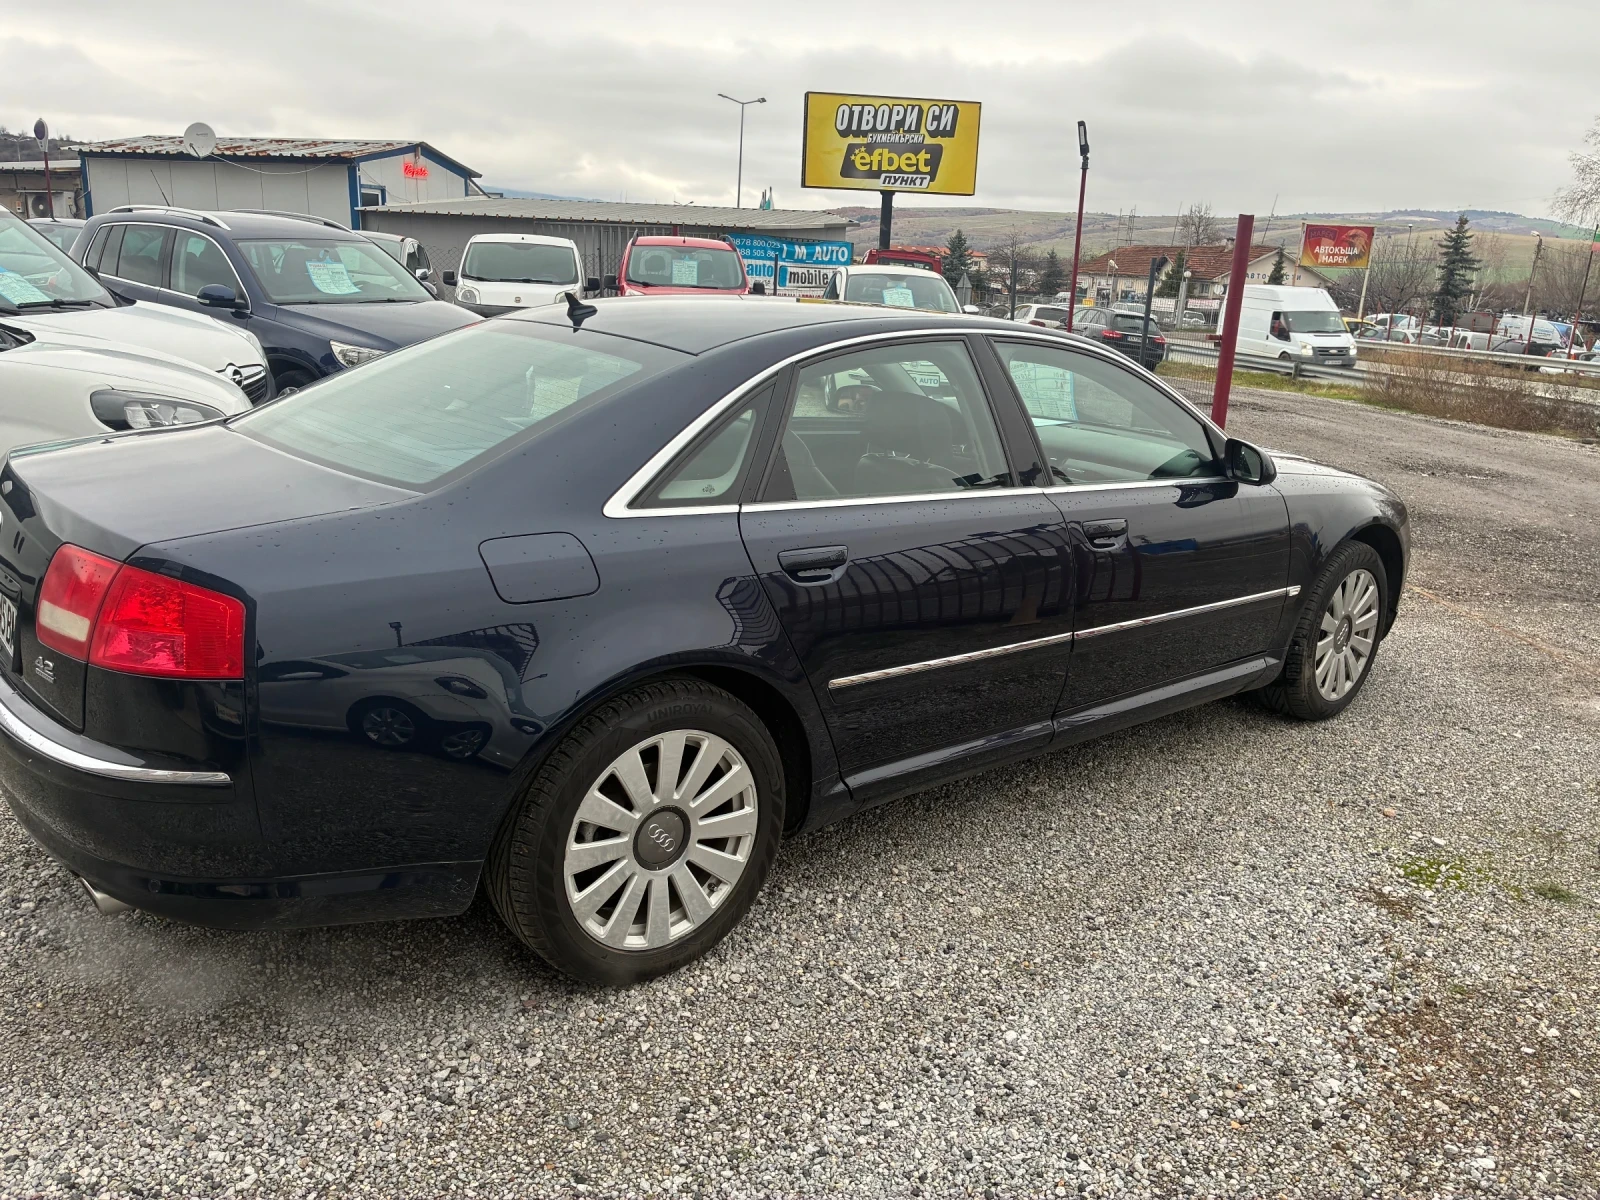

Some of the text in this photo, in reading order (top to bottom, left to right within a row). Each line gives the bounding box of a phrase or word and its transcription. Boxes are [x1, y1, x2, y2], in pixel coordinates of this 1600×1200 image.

[836, 104, 958, 133] ОТВОРИ СИ
[867, 133, 924, 144] БУКМЕЙКЪРСКИ
[854, 148, 931, 172] efbet
[882, 175, 927, 187] ПУНКТ
[753, 239, 765, 247] 800
[753, 249, 765, 257] 505
[1314, 245, 1358, 256] АВТОКЪЩА
[1322, 255, 1348, 264] МАРЕК
[746, 263, 774, 278] auto
[789, 269, 829, 286] mobile
[646, 703, 714, 723] UNIROYAL
